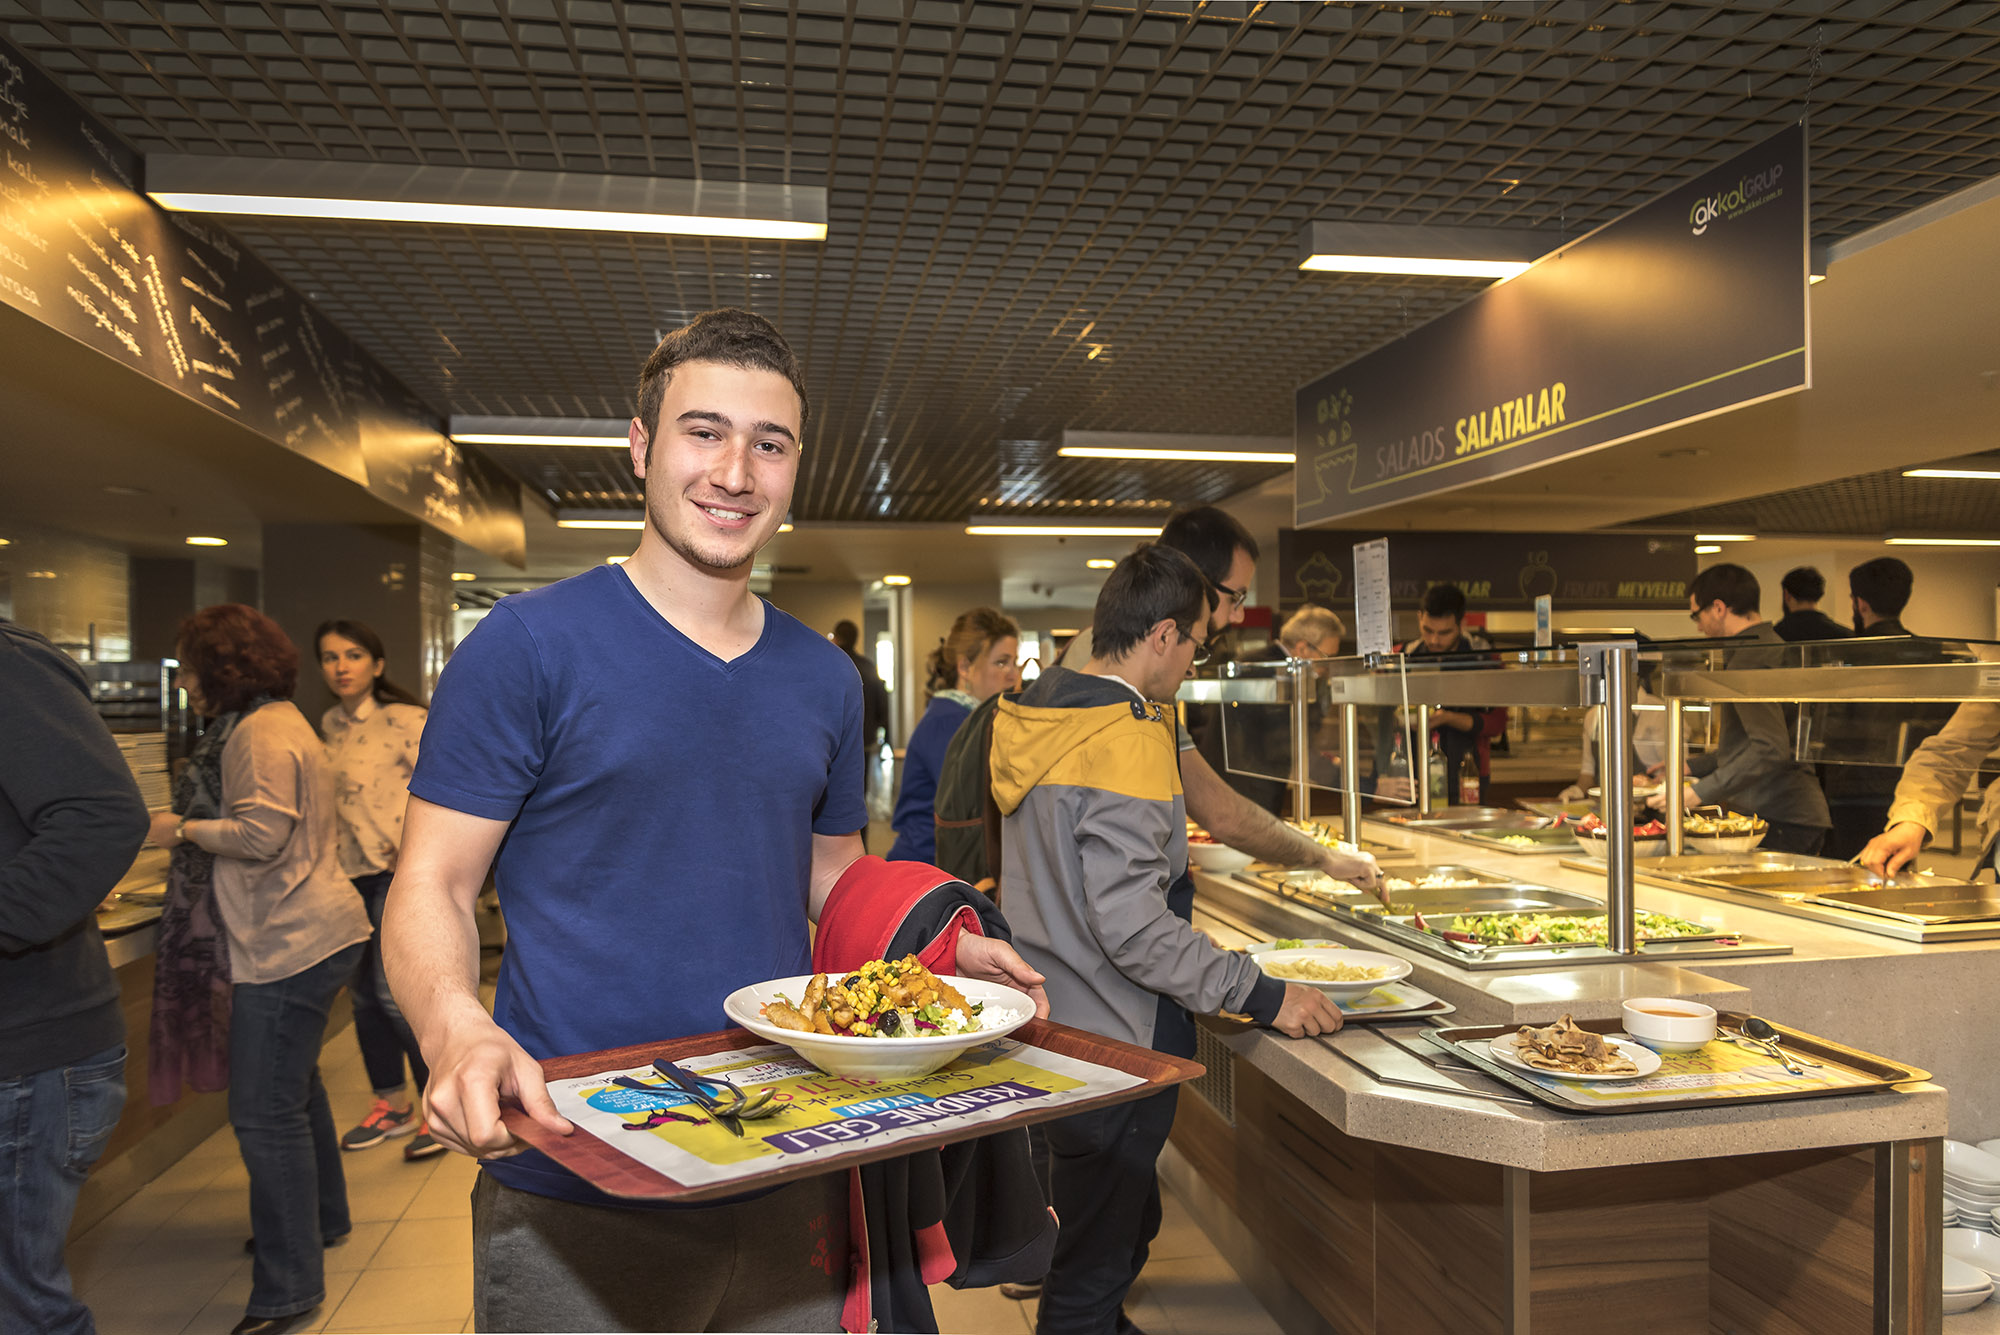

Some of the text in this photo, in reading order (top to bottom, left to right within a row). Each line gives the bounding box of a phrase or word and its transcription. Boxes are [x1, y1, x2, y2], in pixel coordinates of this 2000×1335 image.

[1376, 382, 1567, 478] SALADS SALATALAR
[1616, 580, 1687, 598] MEYVELER
[860, 1071, 974, 1096] Sabahları
[845, 1094, 925, 1116] UYAN!
[783, 1119, 882, 1149] GEL!
